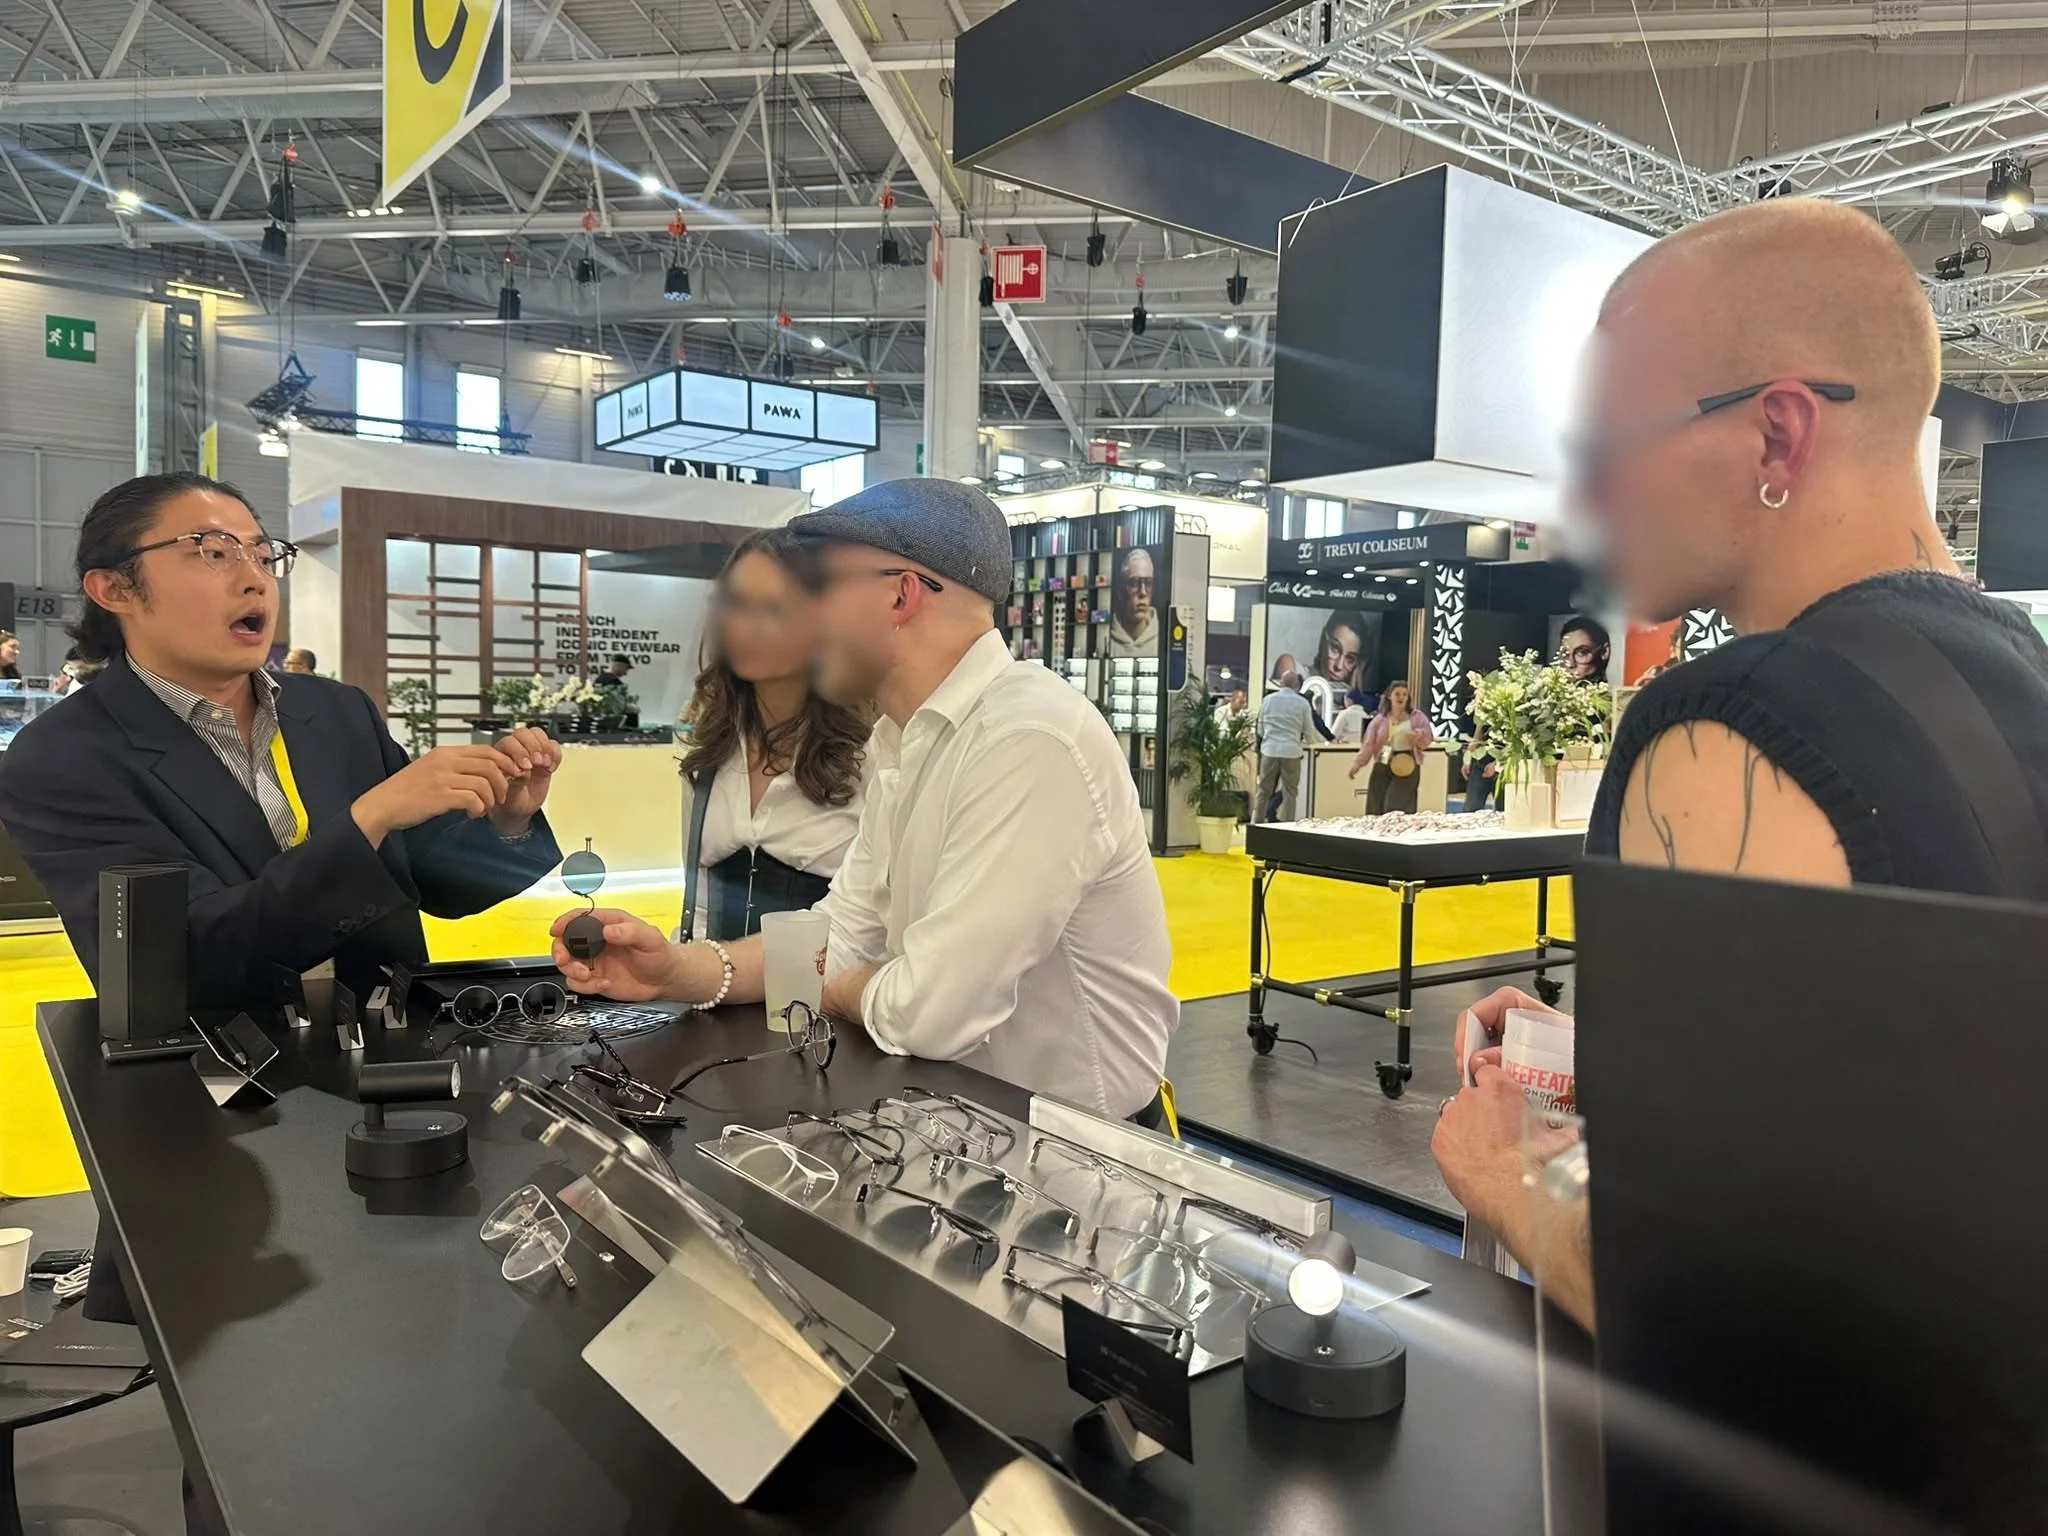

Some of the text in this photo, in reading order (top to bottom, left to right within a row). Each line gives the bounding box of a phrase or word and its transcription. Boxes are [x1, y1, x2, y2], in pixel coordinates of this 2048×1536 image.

[763, 403, 801, 419] PAWA
[1324, 542, 1360, 558] TREVI
[1362, 536, 1428, 554] COLISEUM
[17, 597, 55, 615] E18
[556, 627, 659, 641] INDPENDENT
[611, 641, 680, 653] EYEWEAR
[556, 664, 576, 675] TO
